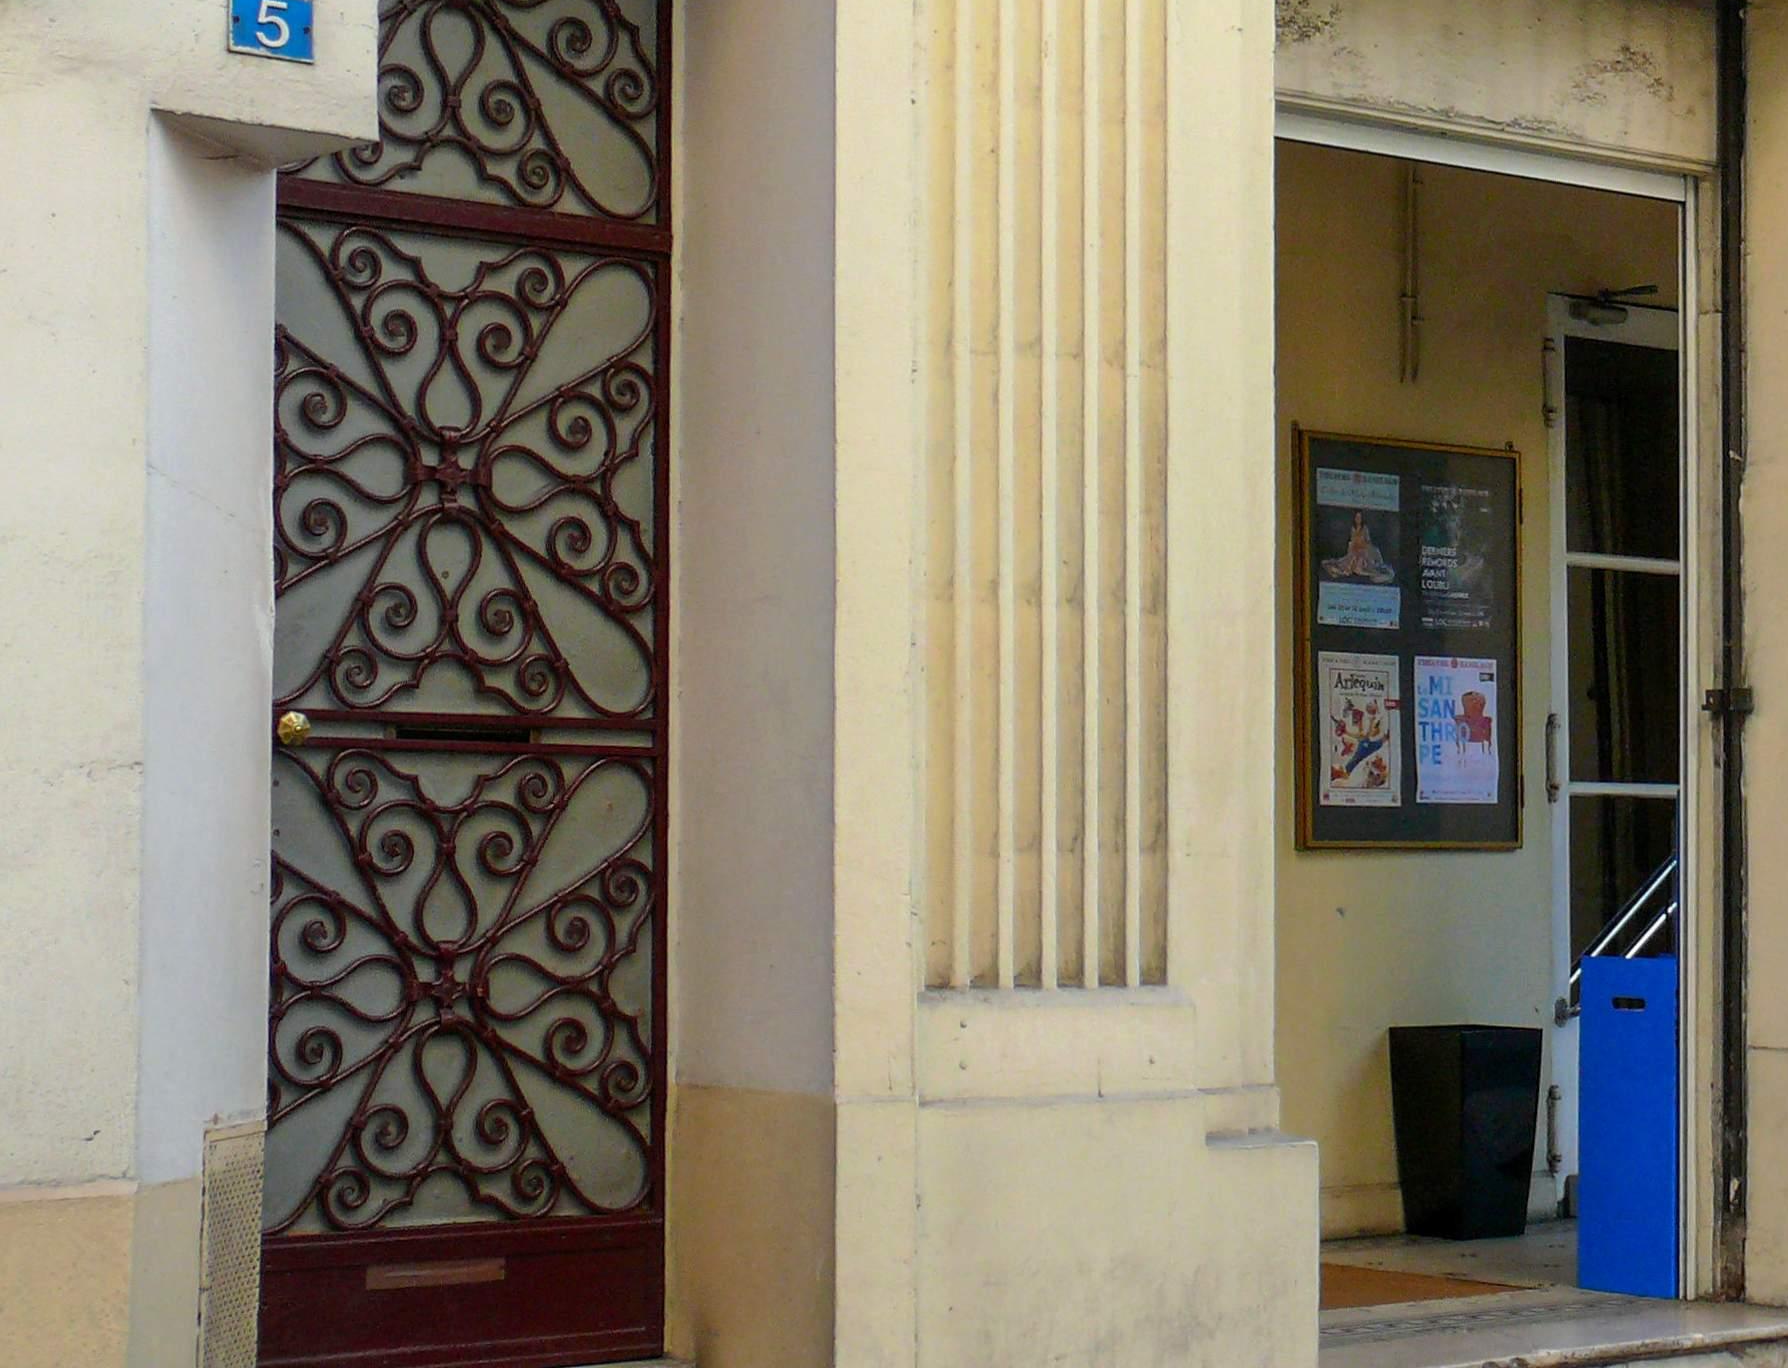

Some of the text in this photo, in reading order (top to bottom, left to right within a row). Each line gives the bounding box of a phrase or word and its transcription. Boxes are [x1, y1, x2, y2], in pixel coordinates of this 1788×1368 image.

[1334, 672, 1385, 692] Arlequin
[1429, 675, 1453, 696] MI
[1418, 698, 1456, 719] SAN
[1418, 721, 1471, 744] THRO
[1419, 743, 1442, 765] PE
